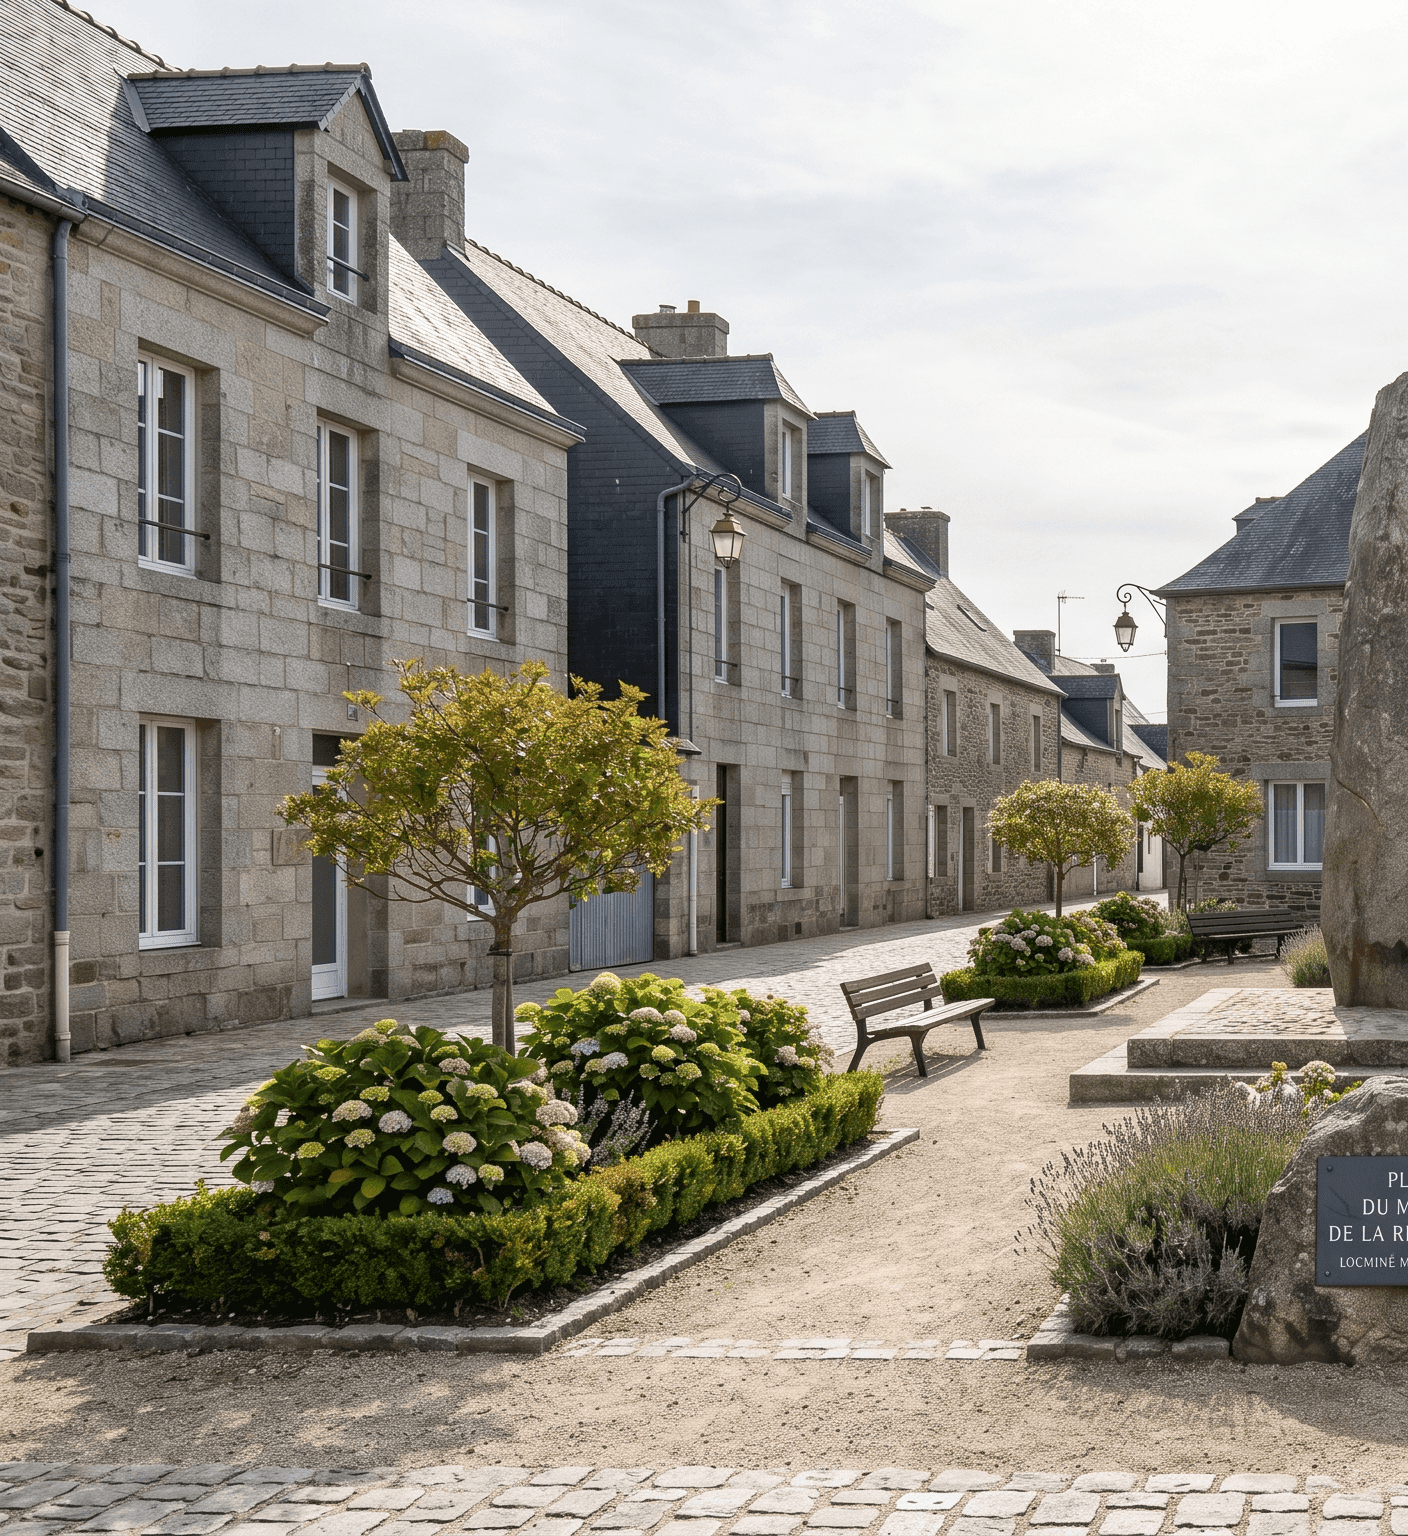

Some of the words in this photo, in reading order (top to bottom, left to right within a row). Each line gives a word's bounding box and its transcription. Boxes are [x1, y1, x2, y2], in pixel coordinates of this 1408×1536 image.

[1362, 1198, 1388, 1216] DU
[1328, 1225, 1354, 1242] DE
[1361, 1225, 1385, 1242] LA
[1339, 1253, 1396, 1268] LOCMINÉ
